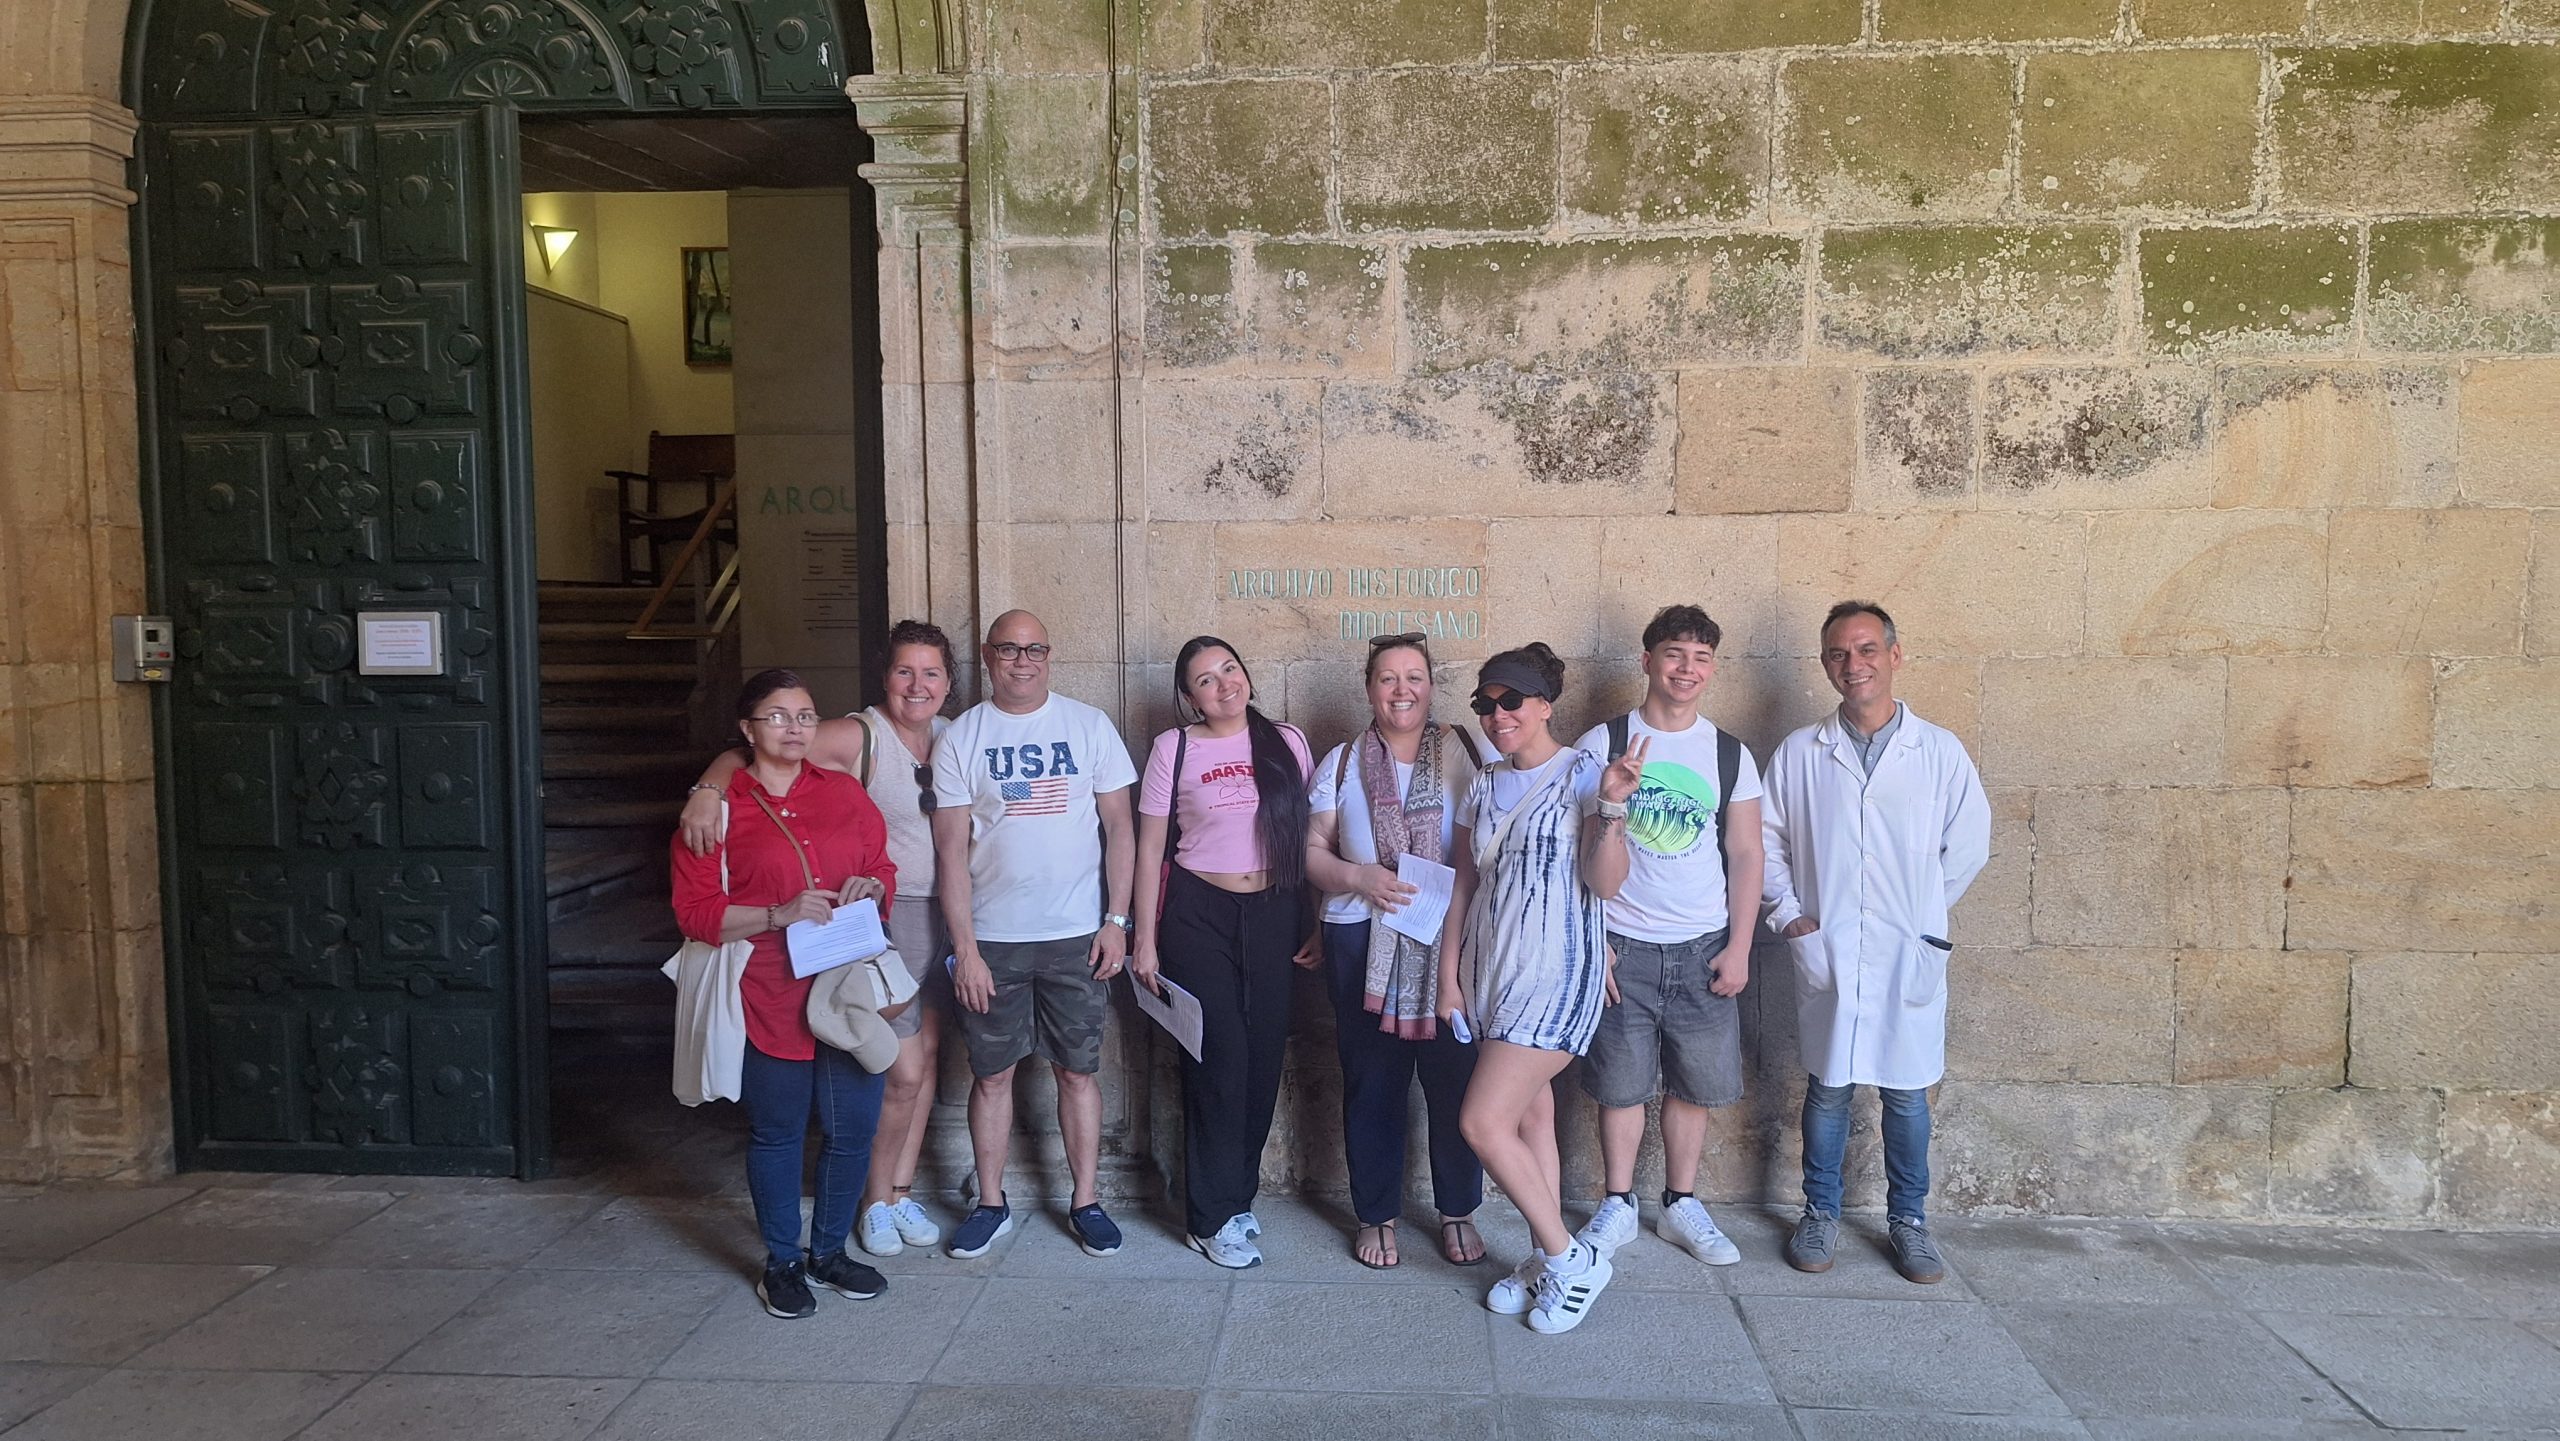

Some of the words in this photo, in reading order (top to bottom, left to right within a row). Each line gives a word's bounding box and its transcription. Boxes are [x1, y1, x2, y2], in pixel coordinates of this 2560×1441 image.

[1229, 568, 1332, 599] ARQUIVO
[1348, 567, 1480, 597] HISTORICO
[1340, 609, 1479, 640] DIOCESANO
[985, 741, 1079, 781] USA
[1200, 765, 1256, 784] BRASI
[1631, 790, 1670, 803] RIDING
[1636, 800, 1675, 811] WAVES
